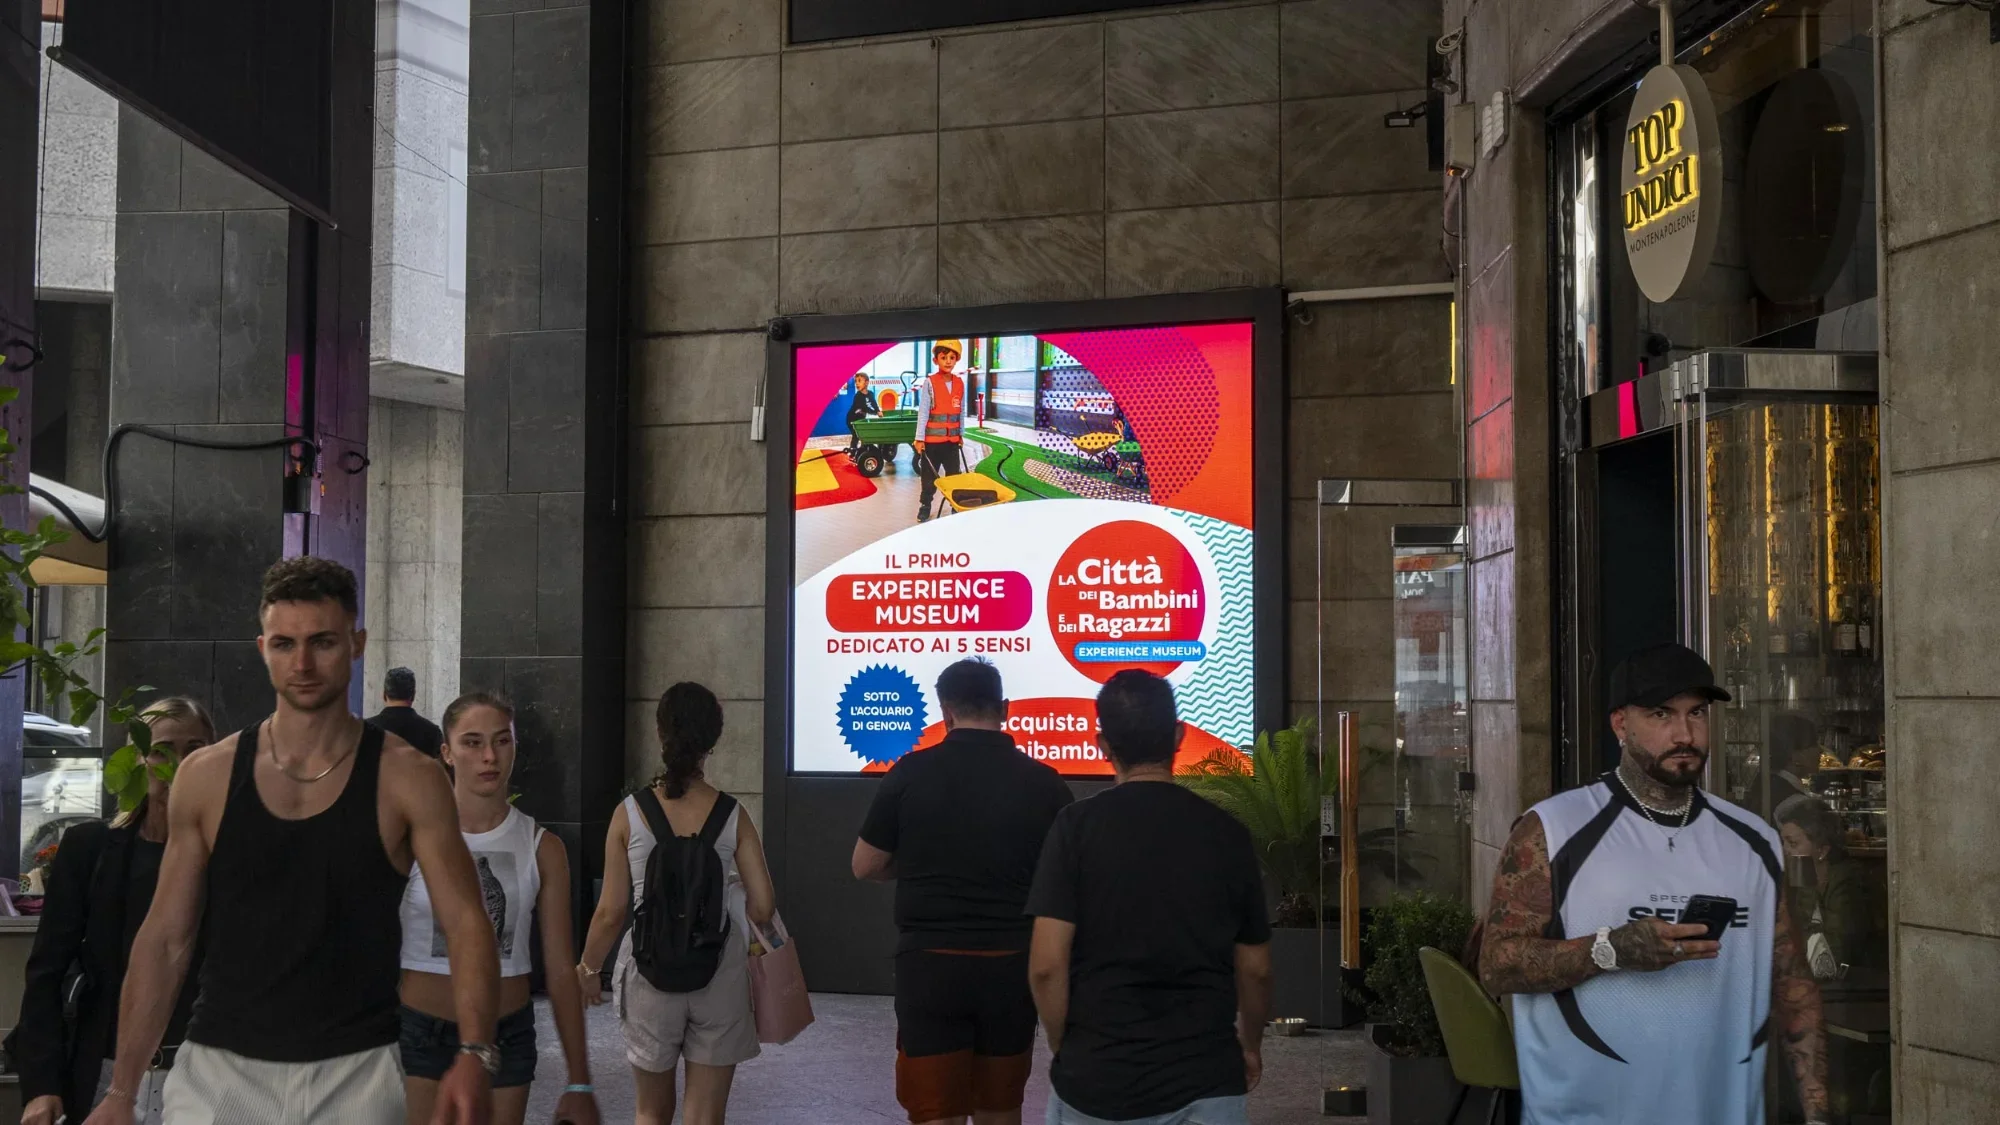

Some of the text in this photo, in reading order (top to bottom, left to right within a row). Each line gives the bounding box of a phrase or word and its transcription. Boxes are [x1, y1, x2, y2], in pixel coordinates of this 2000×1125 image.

[1628, 100, 1684, 174] TOP
[1622, 155, 1698, 230] UNDICI
[1630, 210, 1696, 254] MONTENAPOLEONE
[885, 552, 970, 569] IL PRIMO
[1058, 556, 1163, 585] LA Città
[852, 578, 1005, 600] EXPERIENCE
[1078, 589, 1199, 609] DEI Bambini
[875, 604, 980, 625] MUSEUM
[1058, 614, 1066, 623] E
[1058, 612, 1171, 639] DEI Ragazzi
[827, 637, 1032, 654] DEDICATO AI 5 SENSI
[1078, 645, 1202, 657] EXPERIENCE MUSEUM
[863, 692, 900, 702] SOTTO
[852, 720, 912, 731] DI GENOVA
